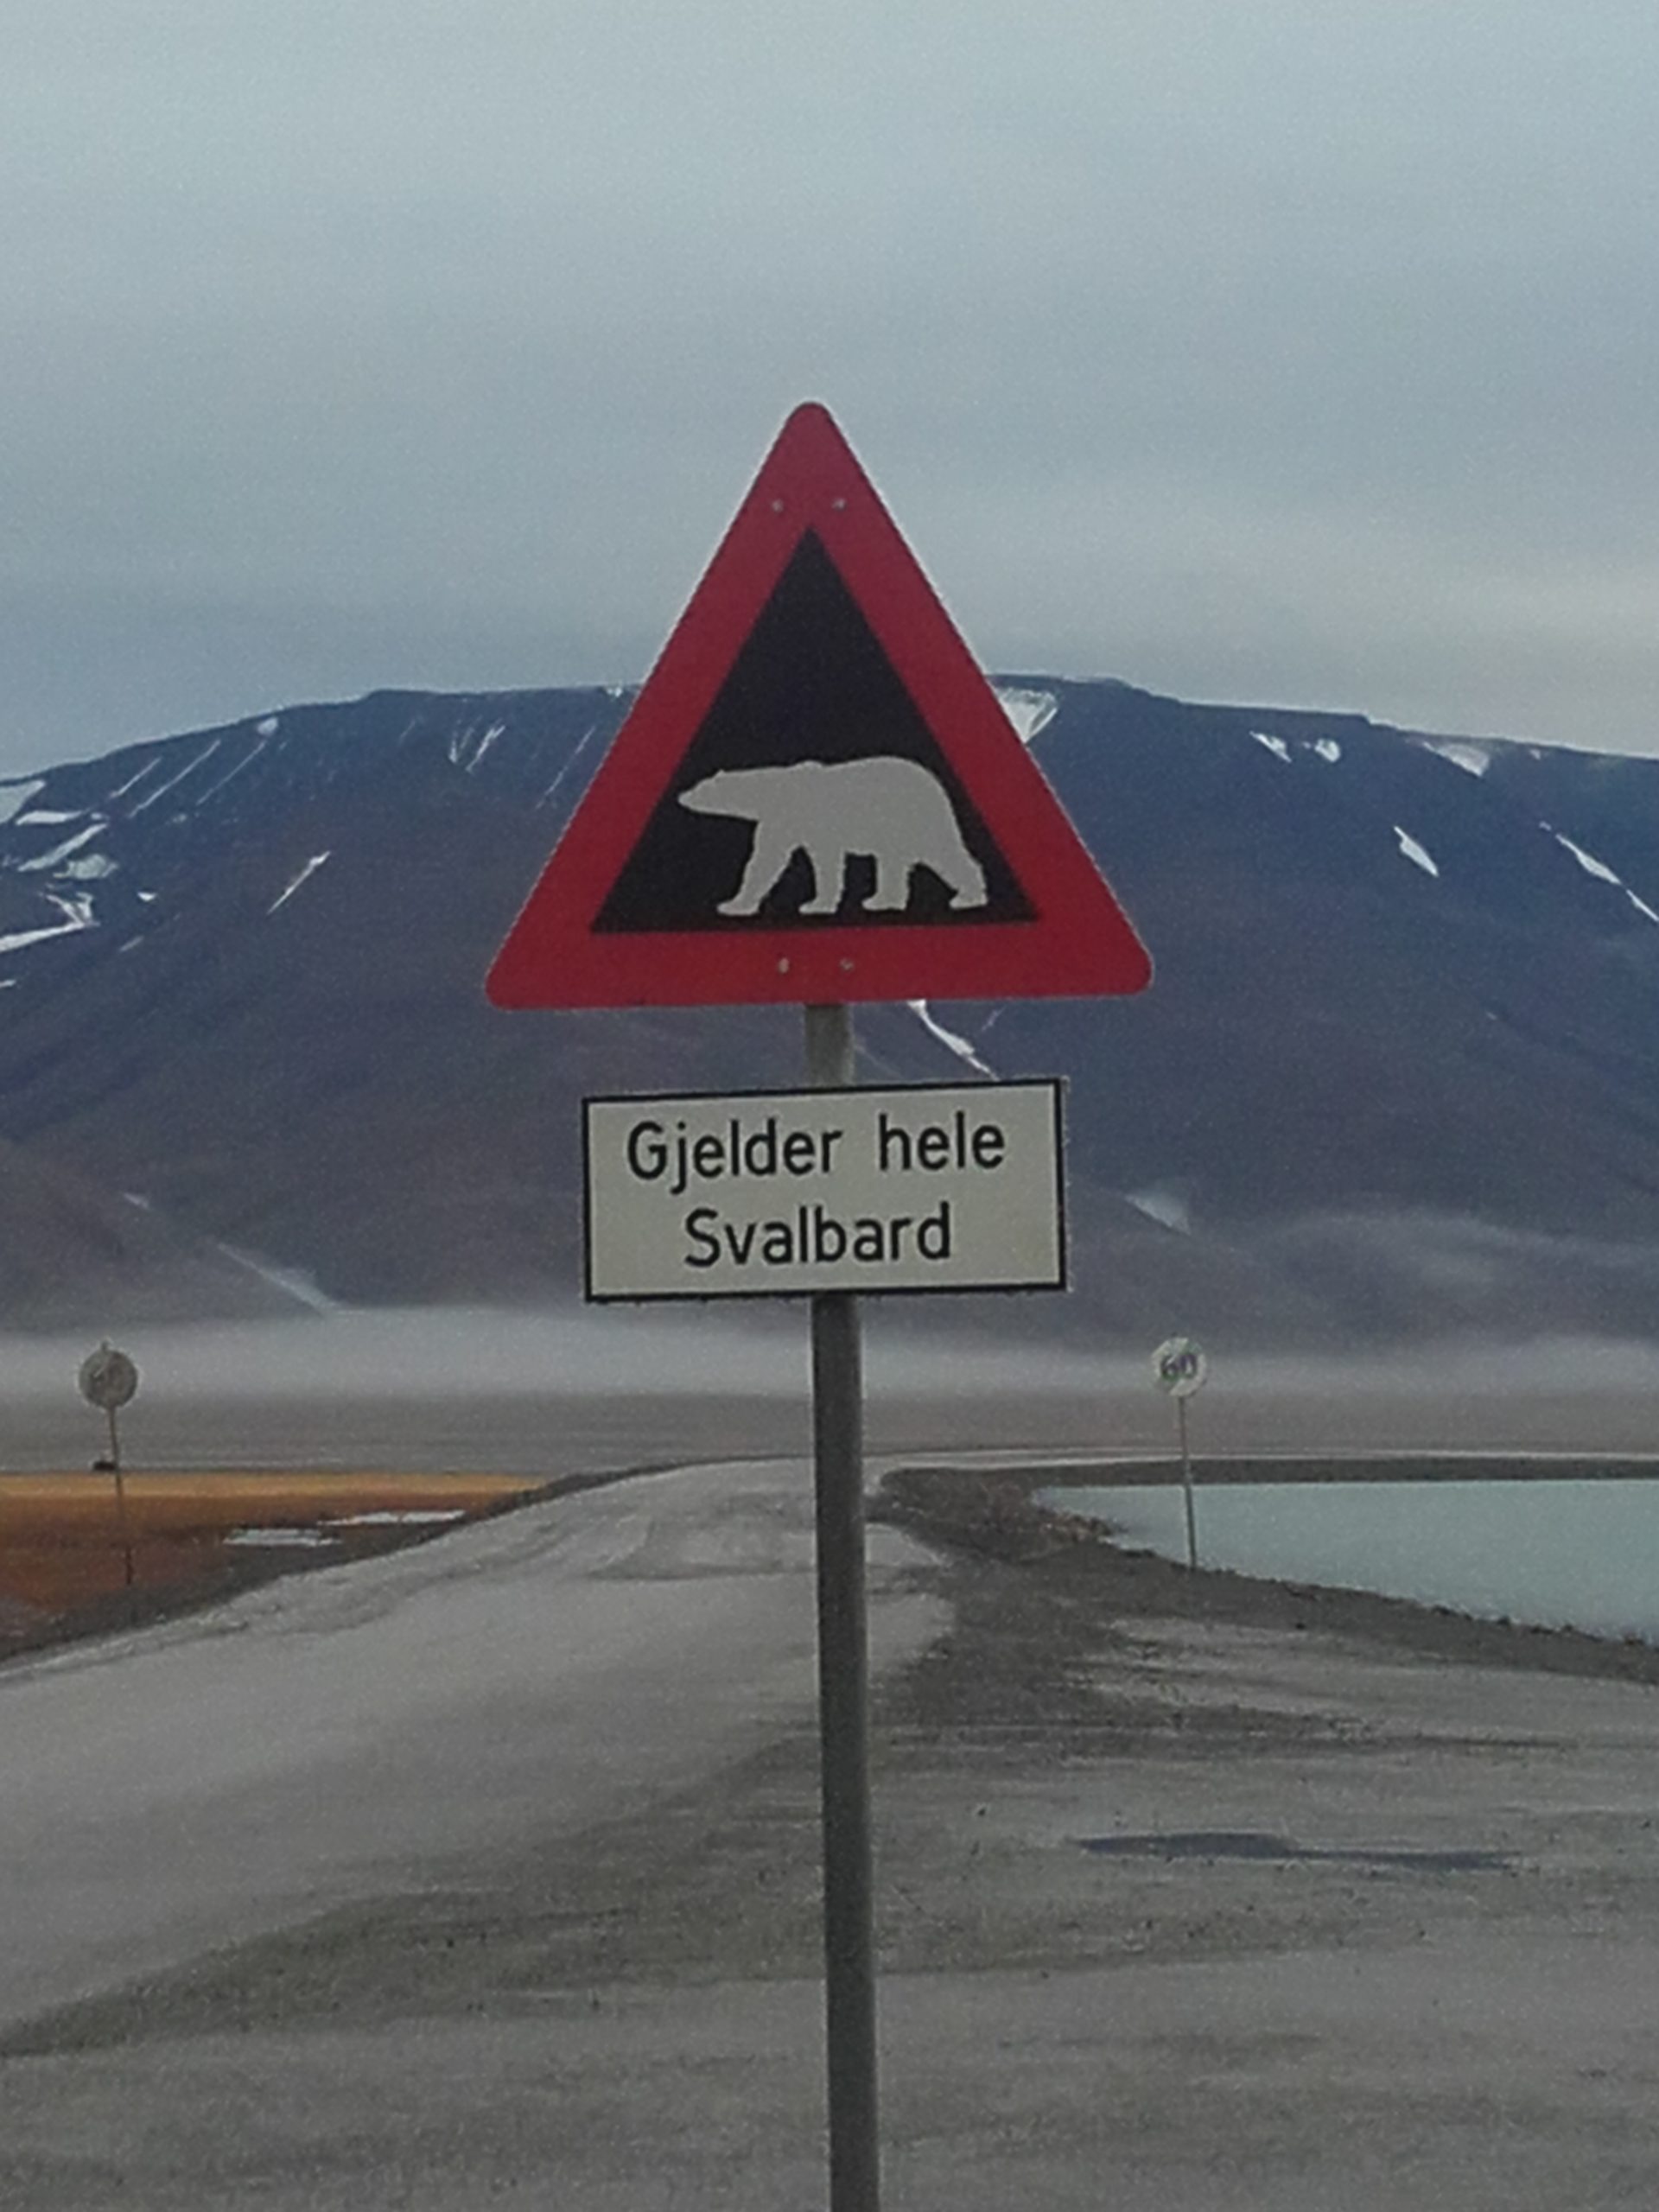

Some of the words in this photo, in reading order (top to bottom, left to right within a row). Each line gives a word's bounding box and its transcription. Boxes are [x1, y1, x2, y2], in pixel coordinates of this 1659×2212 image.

[627, 1116, 842, 1195] Gjelder
[878, 1111, 1006, 1172] hele
[684, 1200, 952, 1268] Svalbard
